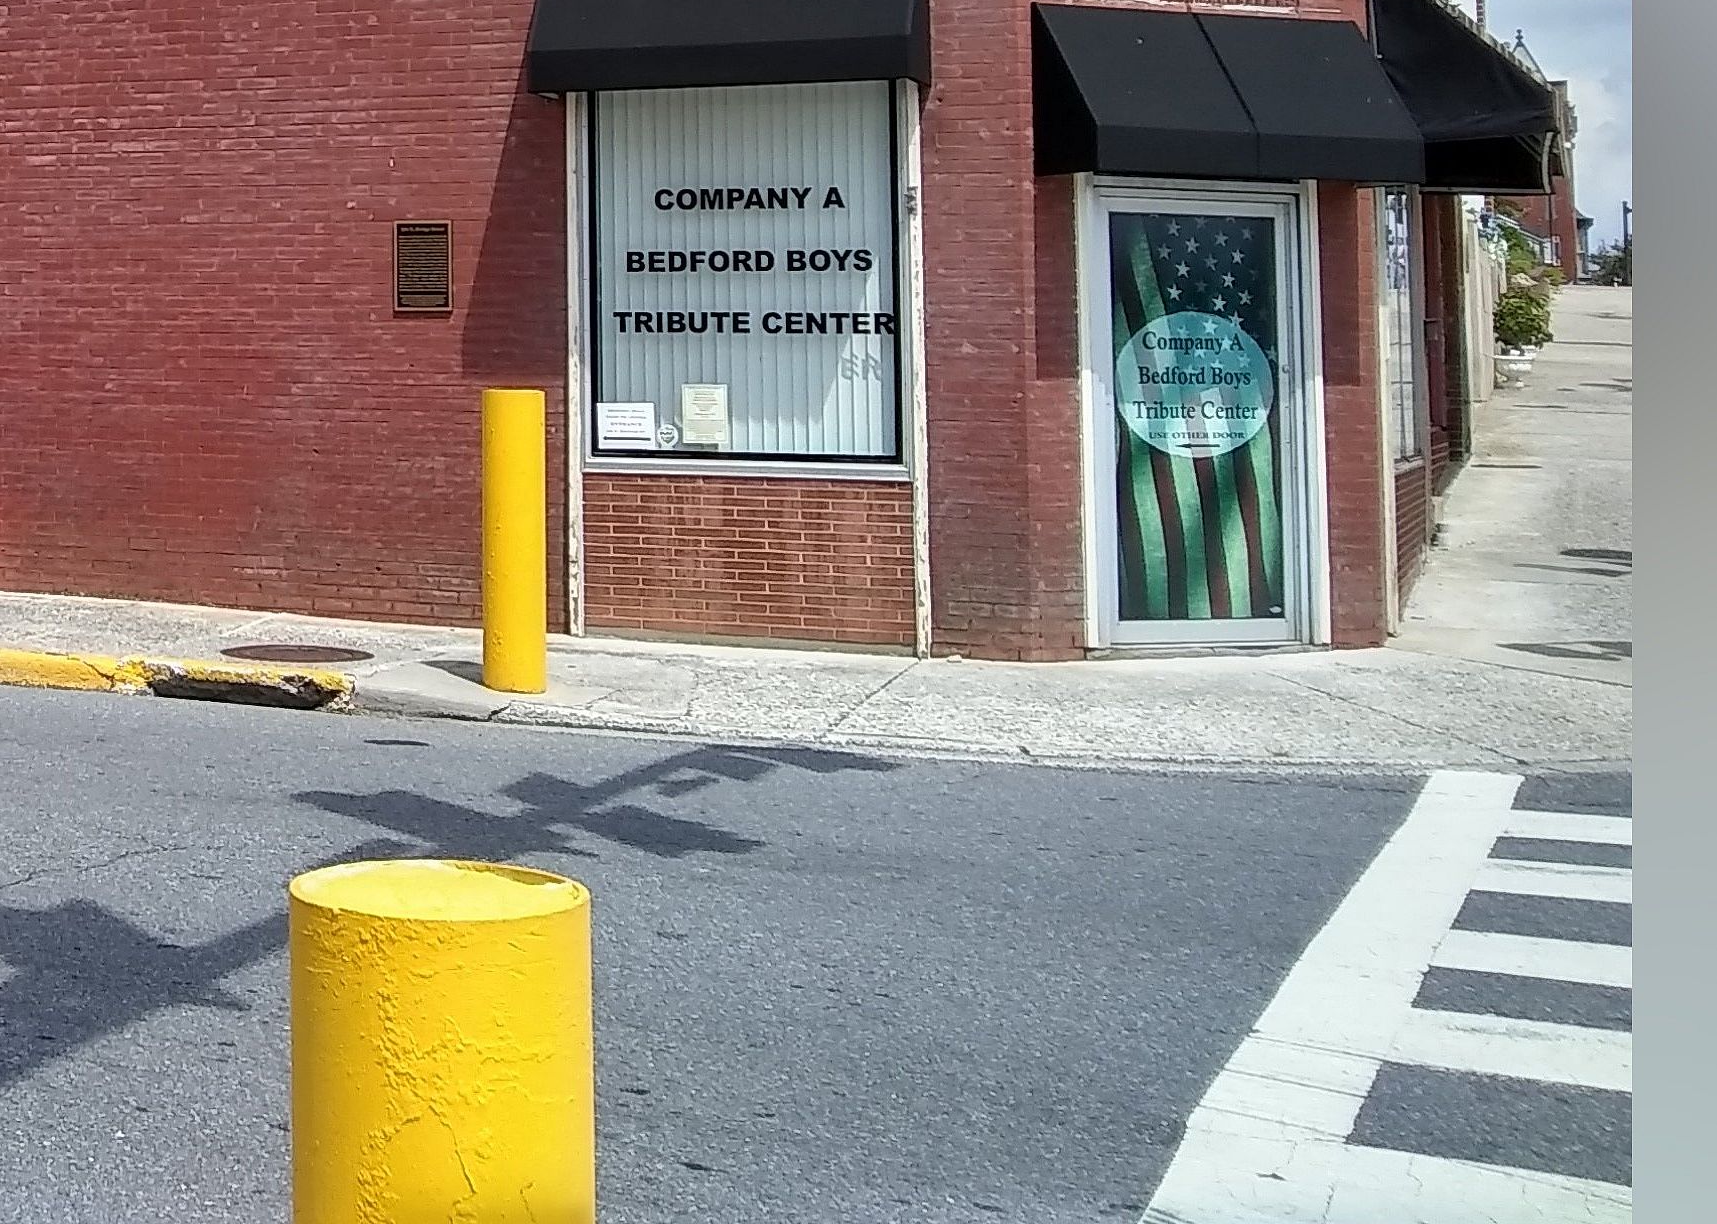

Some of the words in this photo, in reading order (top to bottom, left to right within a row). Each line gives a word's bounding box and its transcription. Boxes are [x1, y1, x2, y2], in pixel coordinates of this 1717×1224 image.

[654, 187, 812, 211] COMPANY
[822, 186, 846, 209] A
[626, 250, 775, 273] BEDFORD
[786, 249, 873, 272] BOYS
[612, 311, 751, 334] TRIBUTE
[761, 312, 896, 335] CENTER
[1142, 330, 1224, 355] Company
[1229, 332, 1245, 351] A
[1137, 365, 1206, 385] Bedford
[1210, 366, 1252, 390] Boys
[1132, 400, 1196, 420] Tribute
[1201, 400, 1259, 420] Center
[1212, 432, 1246, 440] DOOR
